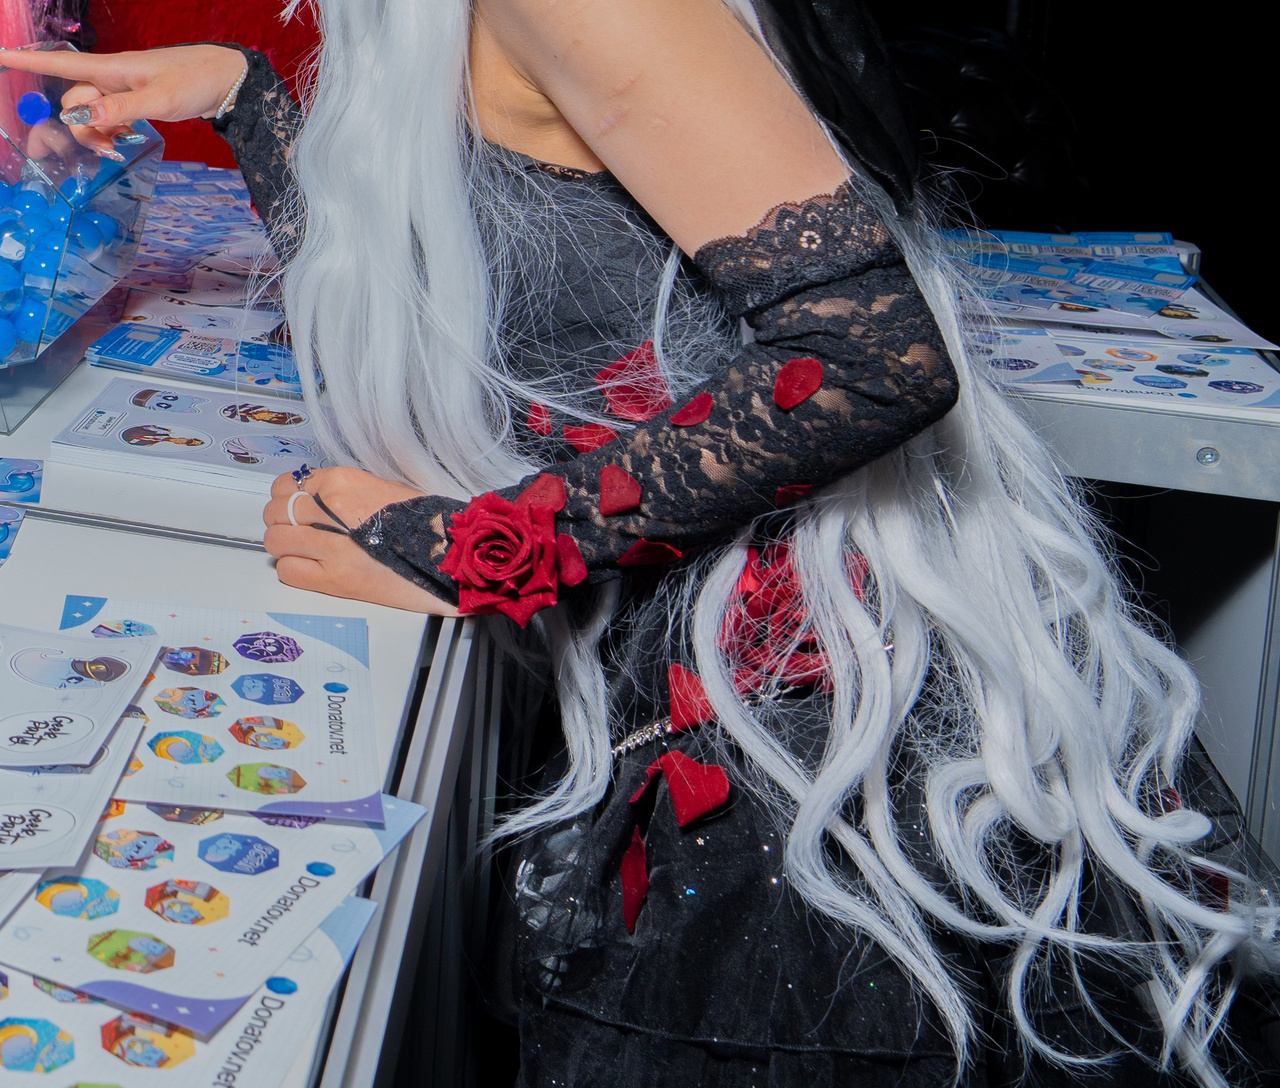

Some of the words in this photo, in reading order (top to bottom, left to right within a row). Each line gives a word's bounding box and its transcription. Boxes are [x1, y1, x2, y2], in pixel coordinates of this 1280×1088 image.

[8, 720, 50, 747] Party
[43, 715, 73, 739] Geek
[327, 694, 347, 756] Donatov.net
[21, 808, 52, 837] Geek
[238, 874, 321, 947] Donatov.net
[212, 995, 285, 1088] Donatov.net
